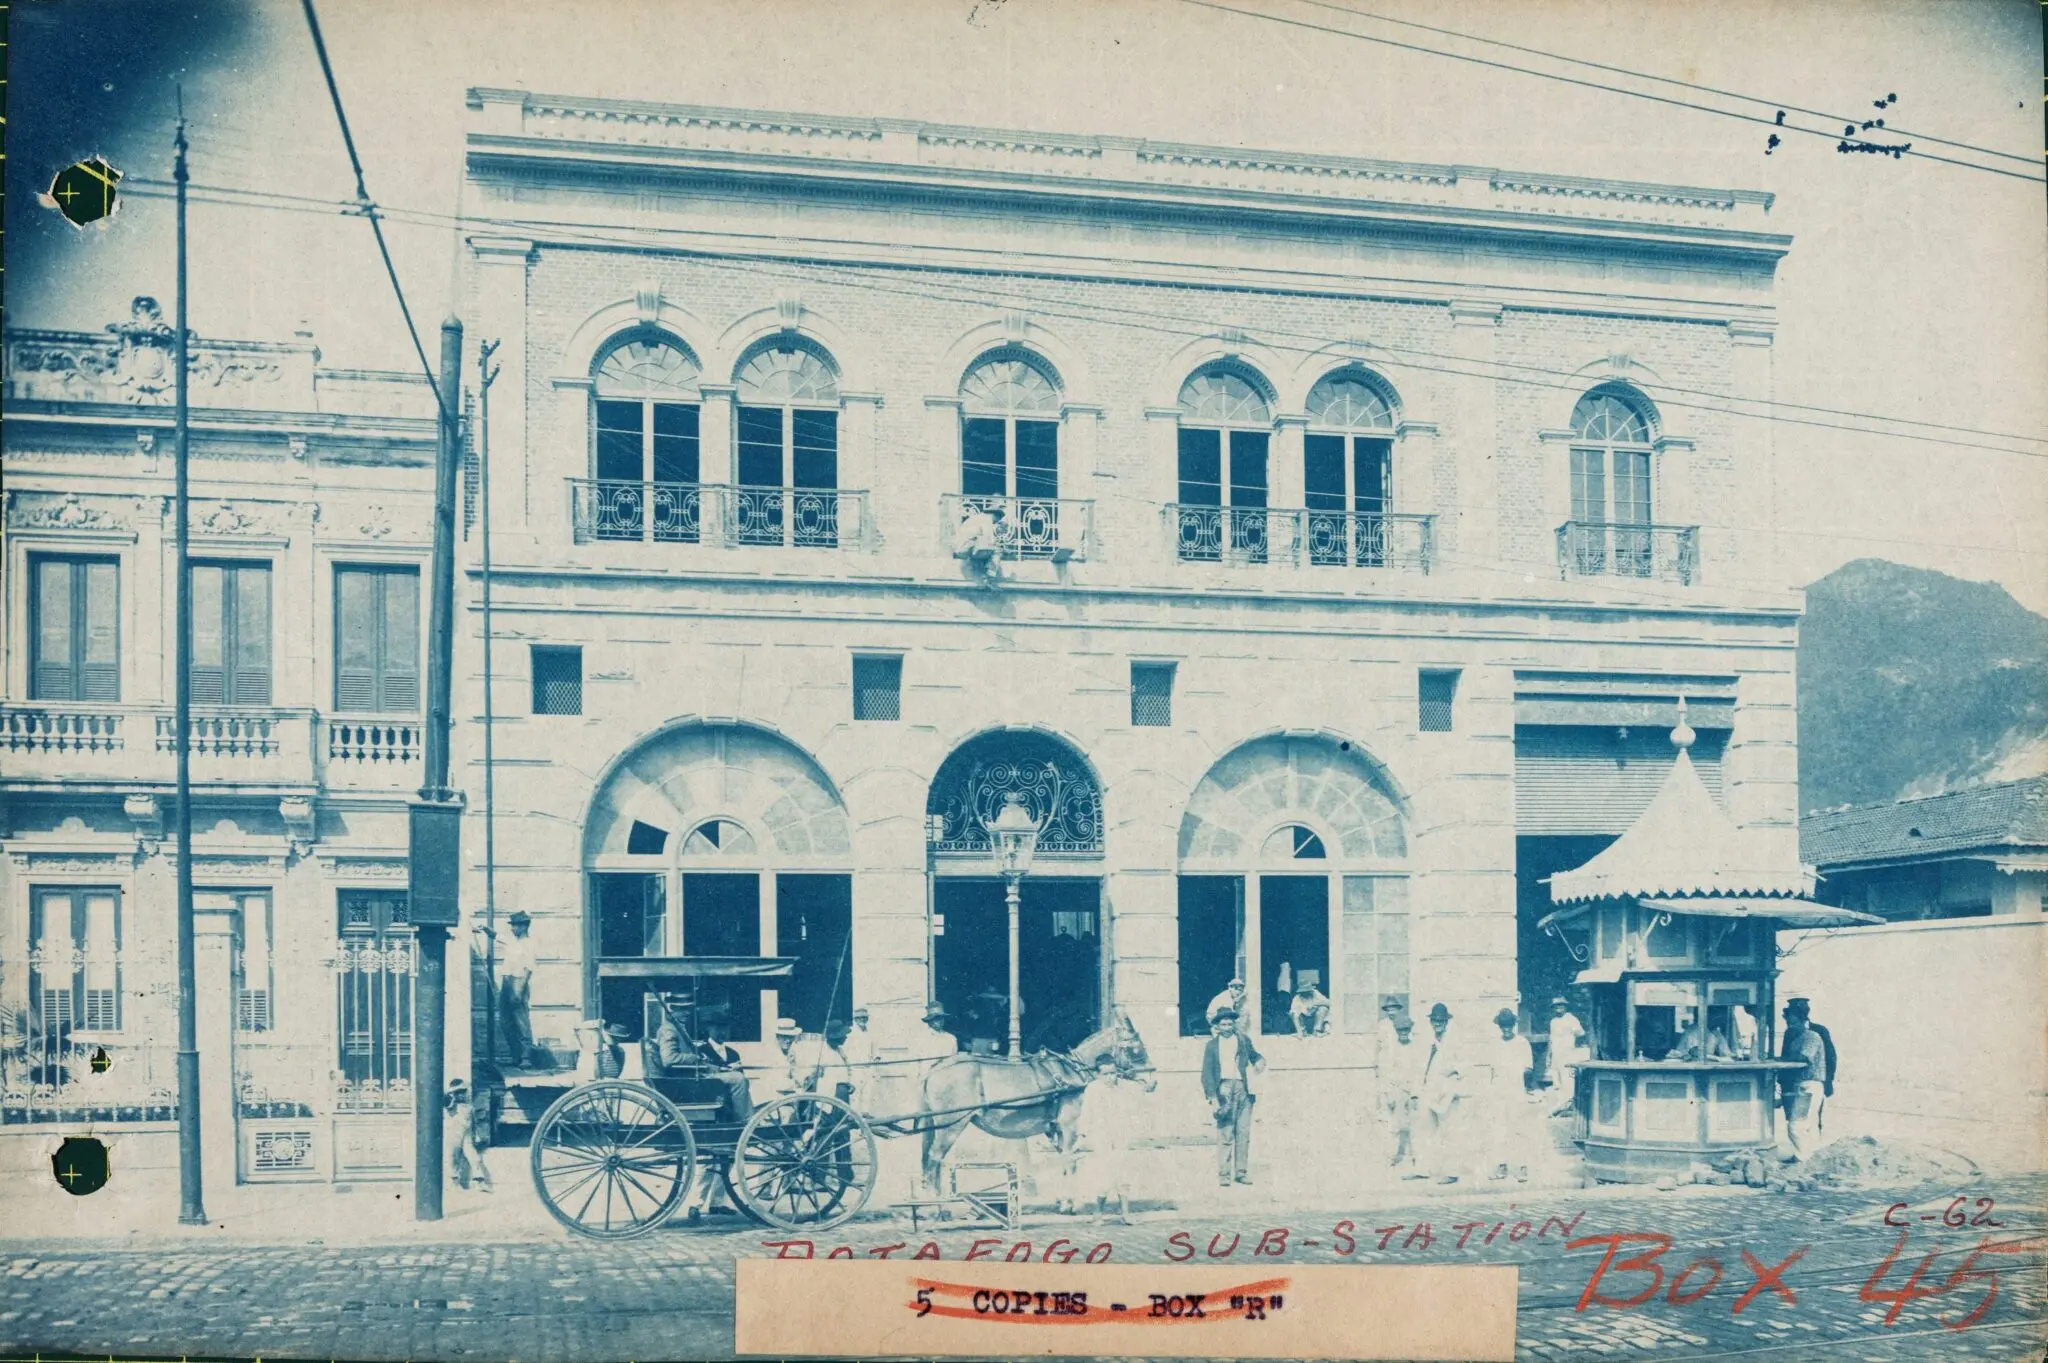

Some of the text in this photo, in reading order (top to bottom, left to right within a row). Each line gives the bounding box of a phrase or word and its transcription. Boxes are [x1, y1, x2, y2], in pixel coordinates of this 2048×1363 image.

[915, 1287, 936, 1318] 5
[973, 1290, 1089, 1316] COPIES
[1148, 1294, 1208, 1318] BOX
[1859, 1230, 2032, 1333] 45
